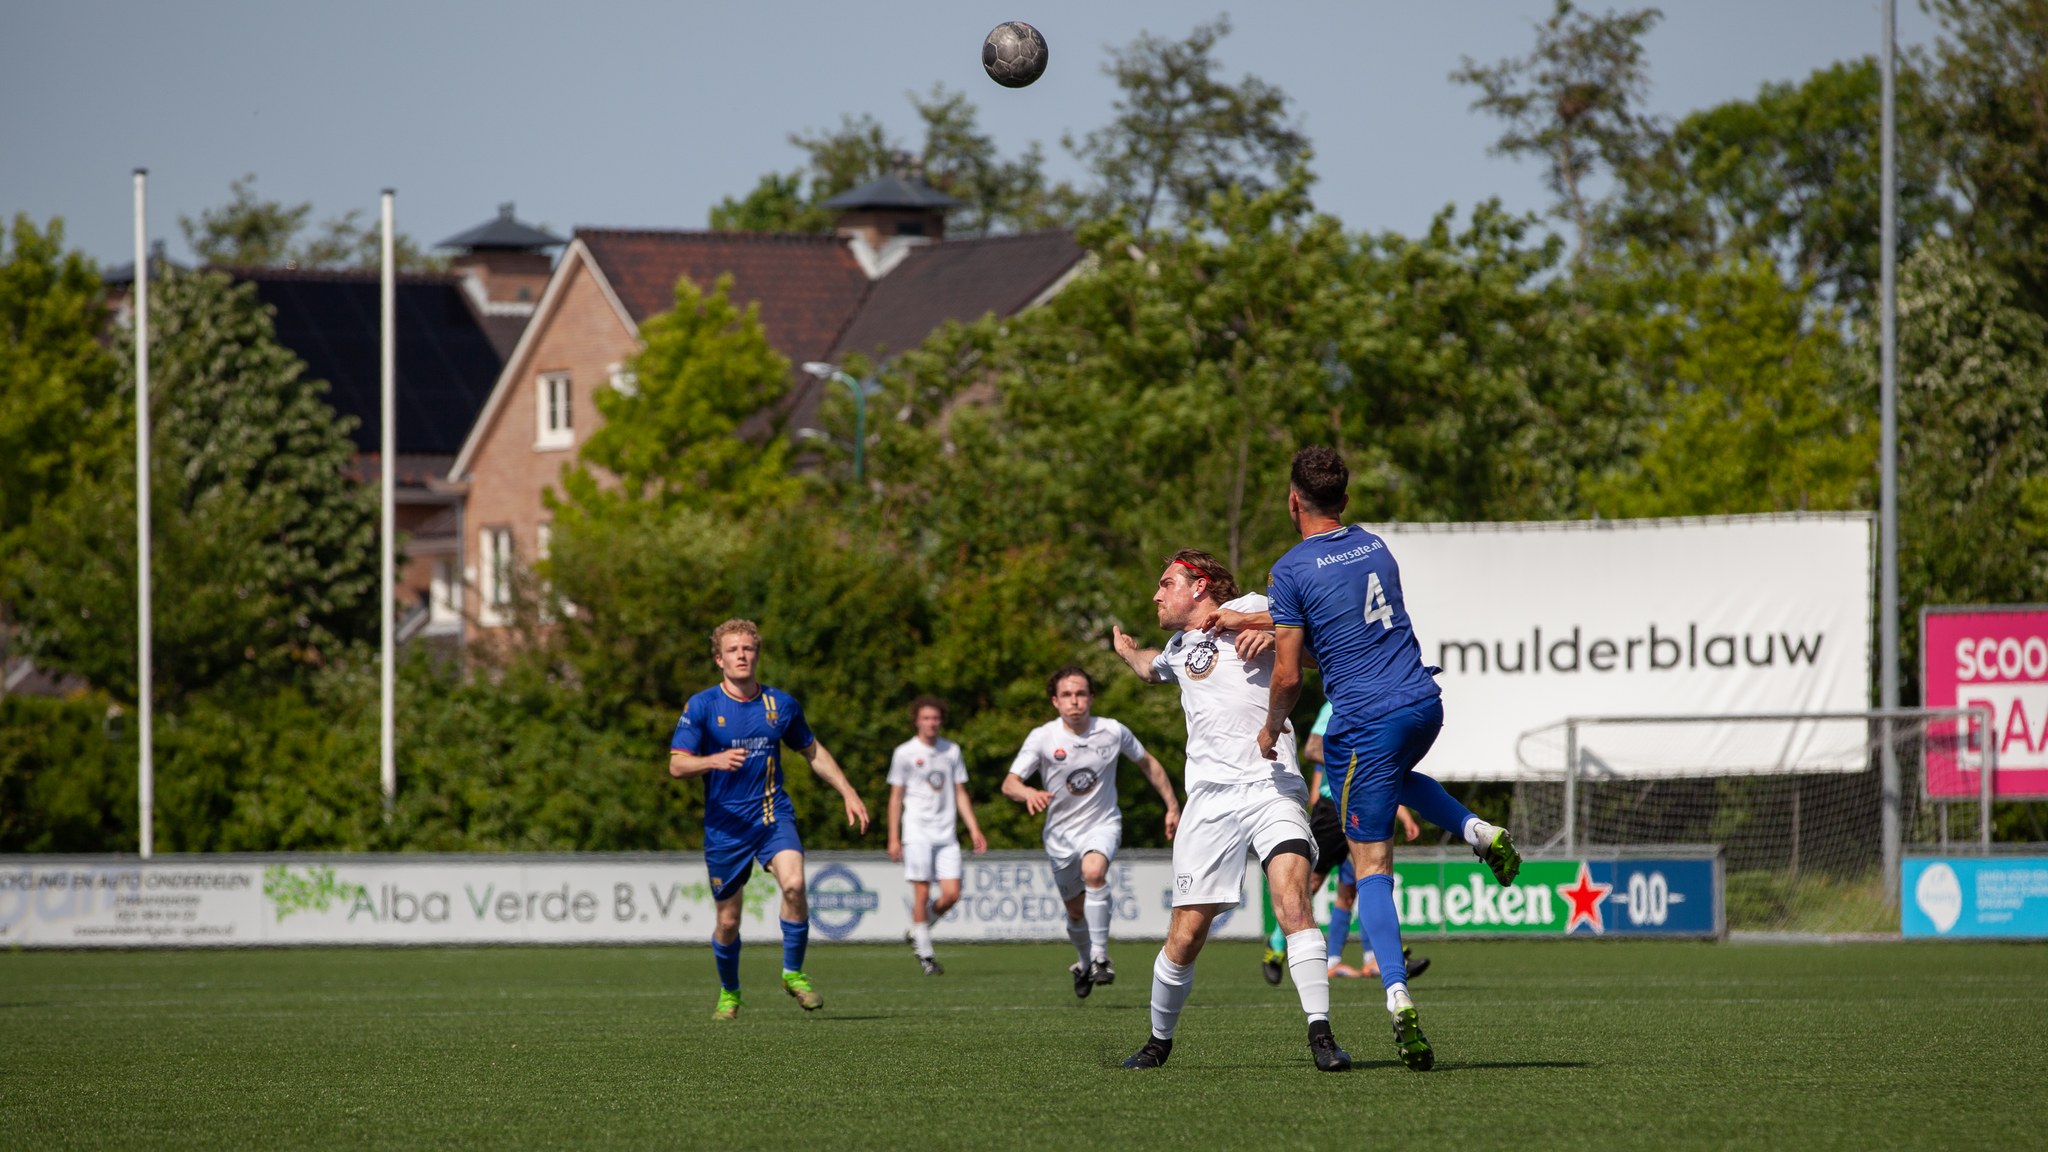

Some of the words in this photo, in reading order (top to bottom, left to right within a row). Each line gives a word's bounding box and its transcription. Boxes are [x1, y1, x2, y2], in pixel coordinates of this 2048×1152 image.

[1316, 540, 1384, 569] Ackersate.nl
[1364, 572, 1394, 630] 4
[1438, 623, 1824, 675] mulderblauw
[1956, 636, 2048, 681] SCOO
[974, 864, 1033, 893] DER
[1312, 871, 1555, 927] Hineken
[348, 883, 451, 923] Alba
[463, 883, 600, 923] Verde
[612, 883, 693, 923] B.V.
